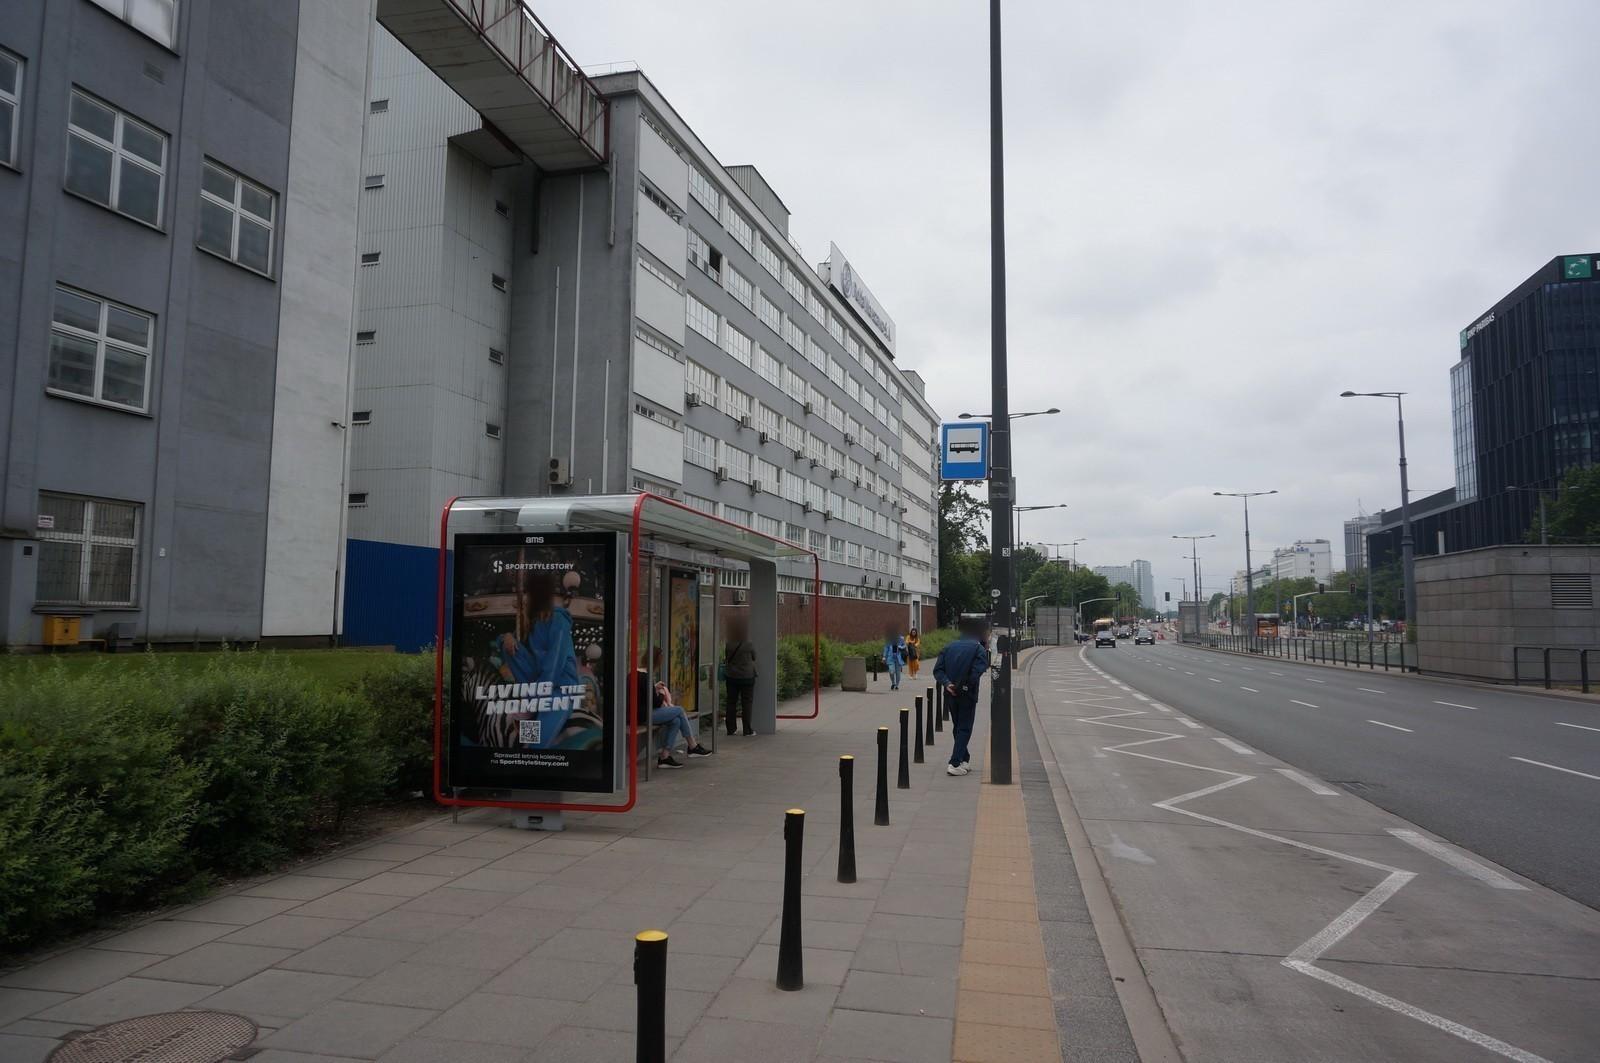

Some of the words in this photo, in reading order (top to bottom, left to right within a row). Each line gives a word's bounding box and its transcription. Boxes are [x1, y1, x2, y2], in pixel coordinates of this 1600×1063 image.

[525, 536, 545, 544] ams
[475, 682, 552, 700] LIVING
[560, 685, 586, 694] THE
[486, 695, 585, 715] MOMENT
